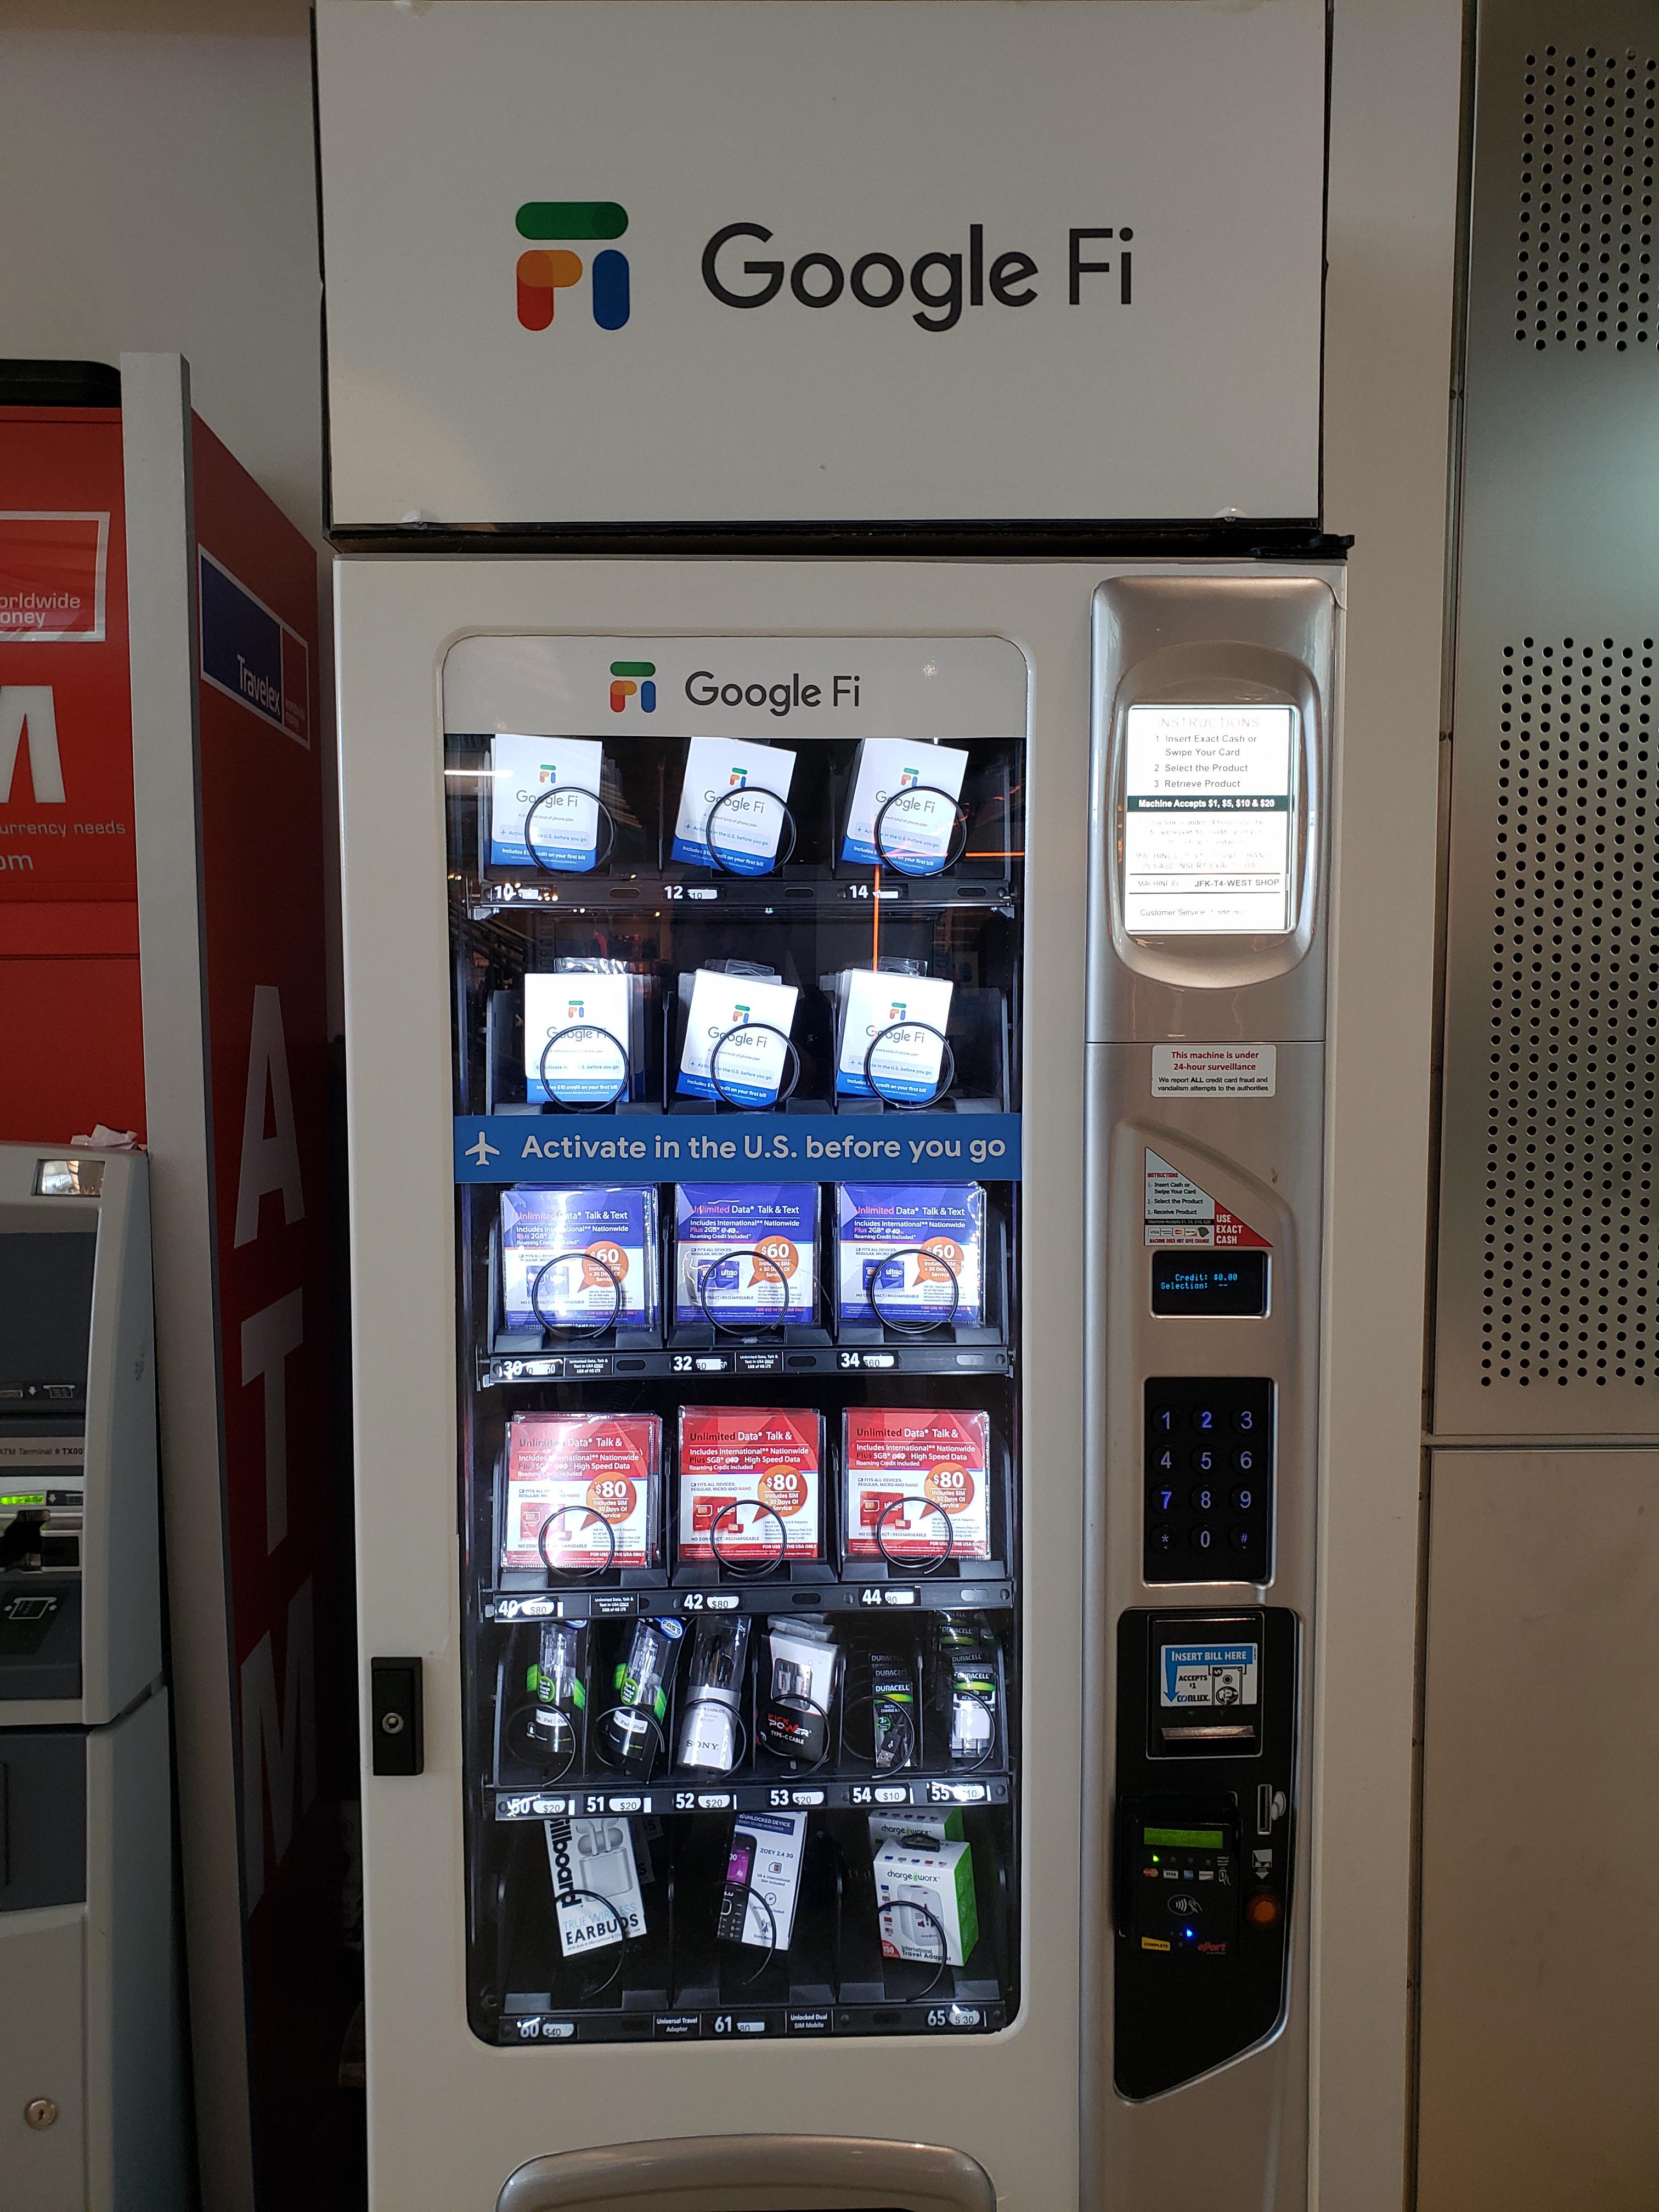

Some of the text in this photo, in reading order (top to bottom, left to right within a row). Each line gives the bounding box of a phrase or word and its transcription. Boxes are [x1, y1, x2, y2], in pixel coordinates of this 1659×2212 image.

[701, 222, 1133, 332] Google Fi
[237, 654, 280, 715] Travelex
[685, 670, 860, 716] Google Fi
[1165, 749, 1192, 757] Swipe
[567, 795, 578, 808] Fi
[1138, 799, 1172, 808] Machine
[1173, 799, 1206, 809] Accepts
[1235, 799, 1250, 808] $10
[1260, 799, 1274, 808] $20
[74, 821, 126, 834] needs
[664, 885, 683, 899] 12
[849, 886, 868, 898] 14
[915, 1031, 924, 1043] Fi
[521, 1135, 1006, 1164] Activate in the U.S. before you go
[923, 1207, 939, 1215] Talk
[1217, 1214, 1231, 1222] USE
[1217, 1225, 1243, 1233] EXACT
[1217, 1235, 1237, 1244] CASH
[761, 1244, 789, 1258] $60
[674, 1356, 692, 1370] 32
[841, 1353, 860, 1367] 34
[1161, 1411, 1252, 1429] 1 2 3
[690, 1433, 736, 1441] Unlimited
[766, 1432, 783, 1440] Talk
[763, 1456, 783, 1464] Speed
[1160, 1451, 1252, 1469] 4 5 6
[767, 1475, 797, 1491] $80
[1161, 1491, 1251, 1509] 7 8 9
[1200, 1531, 1210, 1548] 0
[684, 1594, 703, 1609] 42
[862, 1590, 882, 1604] 44
[1172, 1651, 1203, 1661] INSERT
[1205, 1652, 1223, 1661] BILL
[1225, 1651, 1246, 1660] HERE
[771, 1730, 804, 1744] TYPE-C CABLE
[676, 1793, 695, 1808] 52
[770, 1790, 789, 1805] 53
[853, 1787, 871, 1803] 54
[587, 1797, 604, 1812] 51
[744, 1815, 791, 1827] UNLOCKED DEVICE
[887, 1870, 913, 1880] charge
[566, 1914, 639, 1945] EARBUDS
[715, 2016, 732, 2033] 61
[928, 2010, 946, 2026] 65
